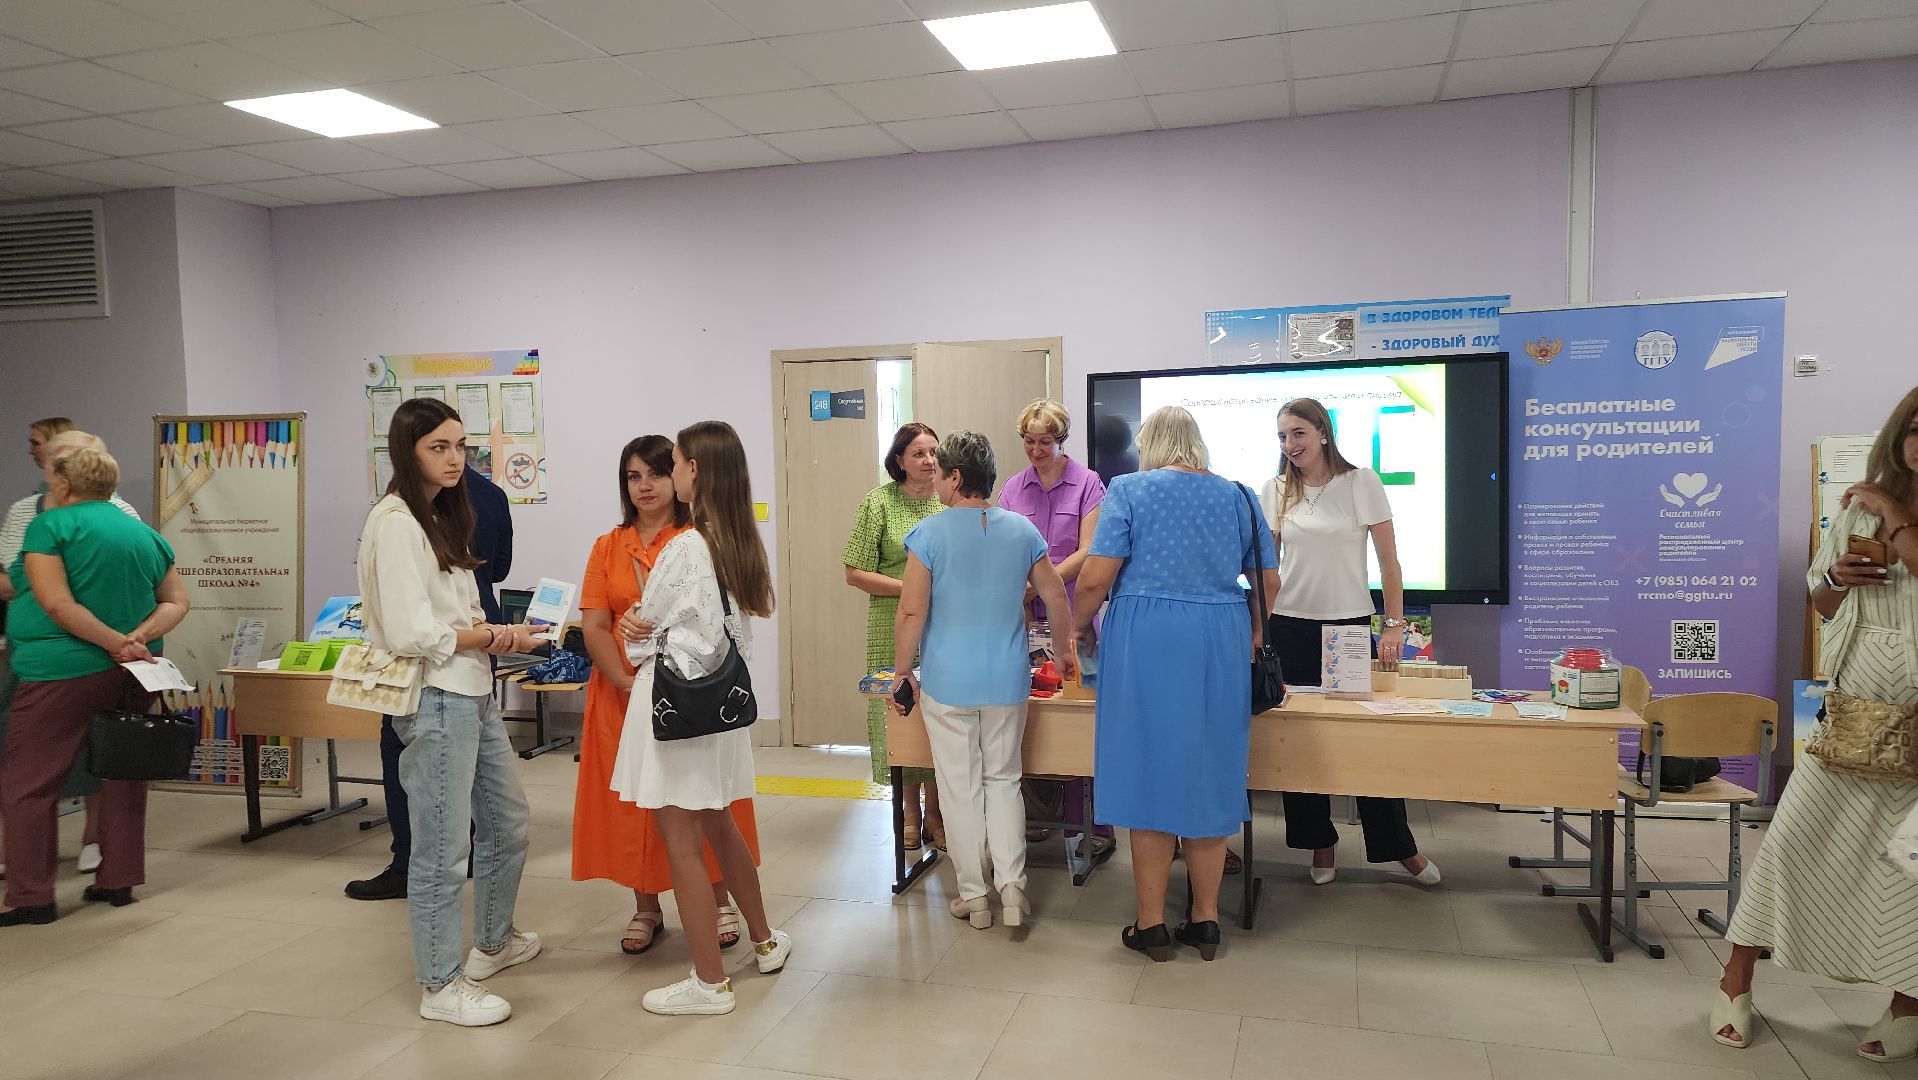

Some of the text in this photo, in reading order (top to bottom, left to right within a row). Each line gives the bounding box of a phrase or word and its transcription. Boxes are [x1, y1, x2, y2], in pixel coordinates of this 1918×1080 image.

[1382, 309, 1463, 323] ЗДОРОВОМ
[1382, 334, 1466, 350] ЗДОРОВЫЙ
[1472, 335, 1500, 347] ДУХ
[1525, 398, 1676, 416] Бесплатные
[1524, 419, 1701, 440] консультации
[1524, 435, 1714, 461] для родителей
[1660, 508, 1722, 518] Счастливая
[1675, 521, 1706, 529] семья
[1524, 533, 1568, 541] Информация
[176, 567, 290, 576] БЩЕОБРАЗОВАТЕЛЬНАЯ
[198, 579, 236, 588] ШКОЛА
[1635, 575, 1758, 588] +7 (985) 064 21 02
[1638, 590, 1733, 602] rrcmo@ggtu.ru
[1658, 668, 1733, 679] ЗАПИШИСЬ
